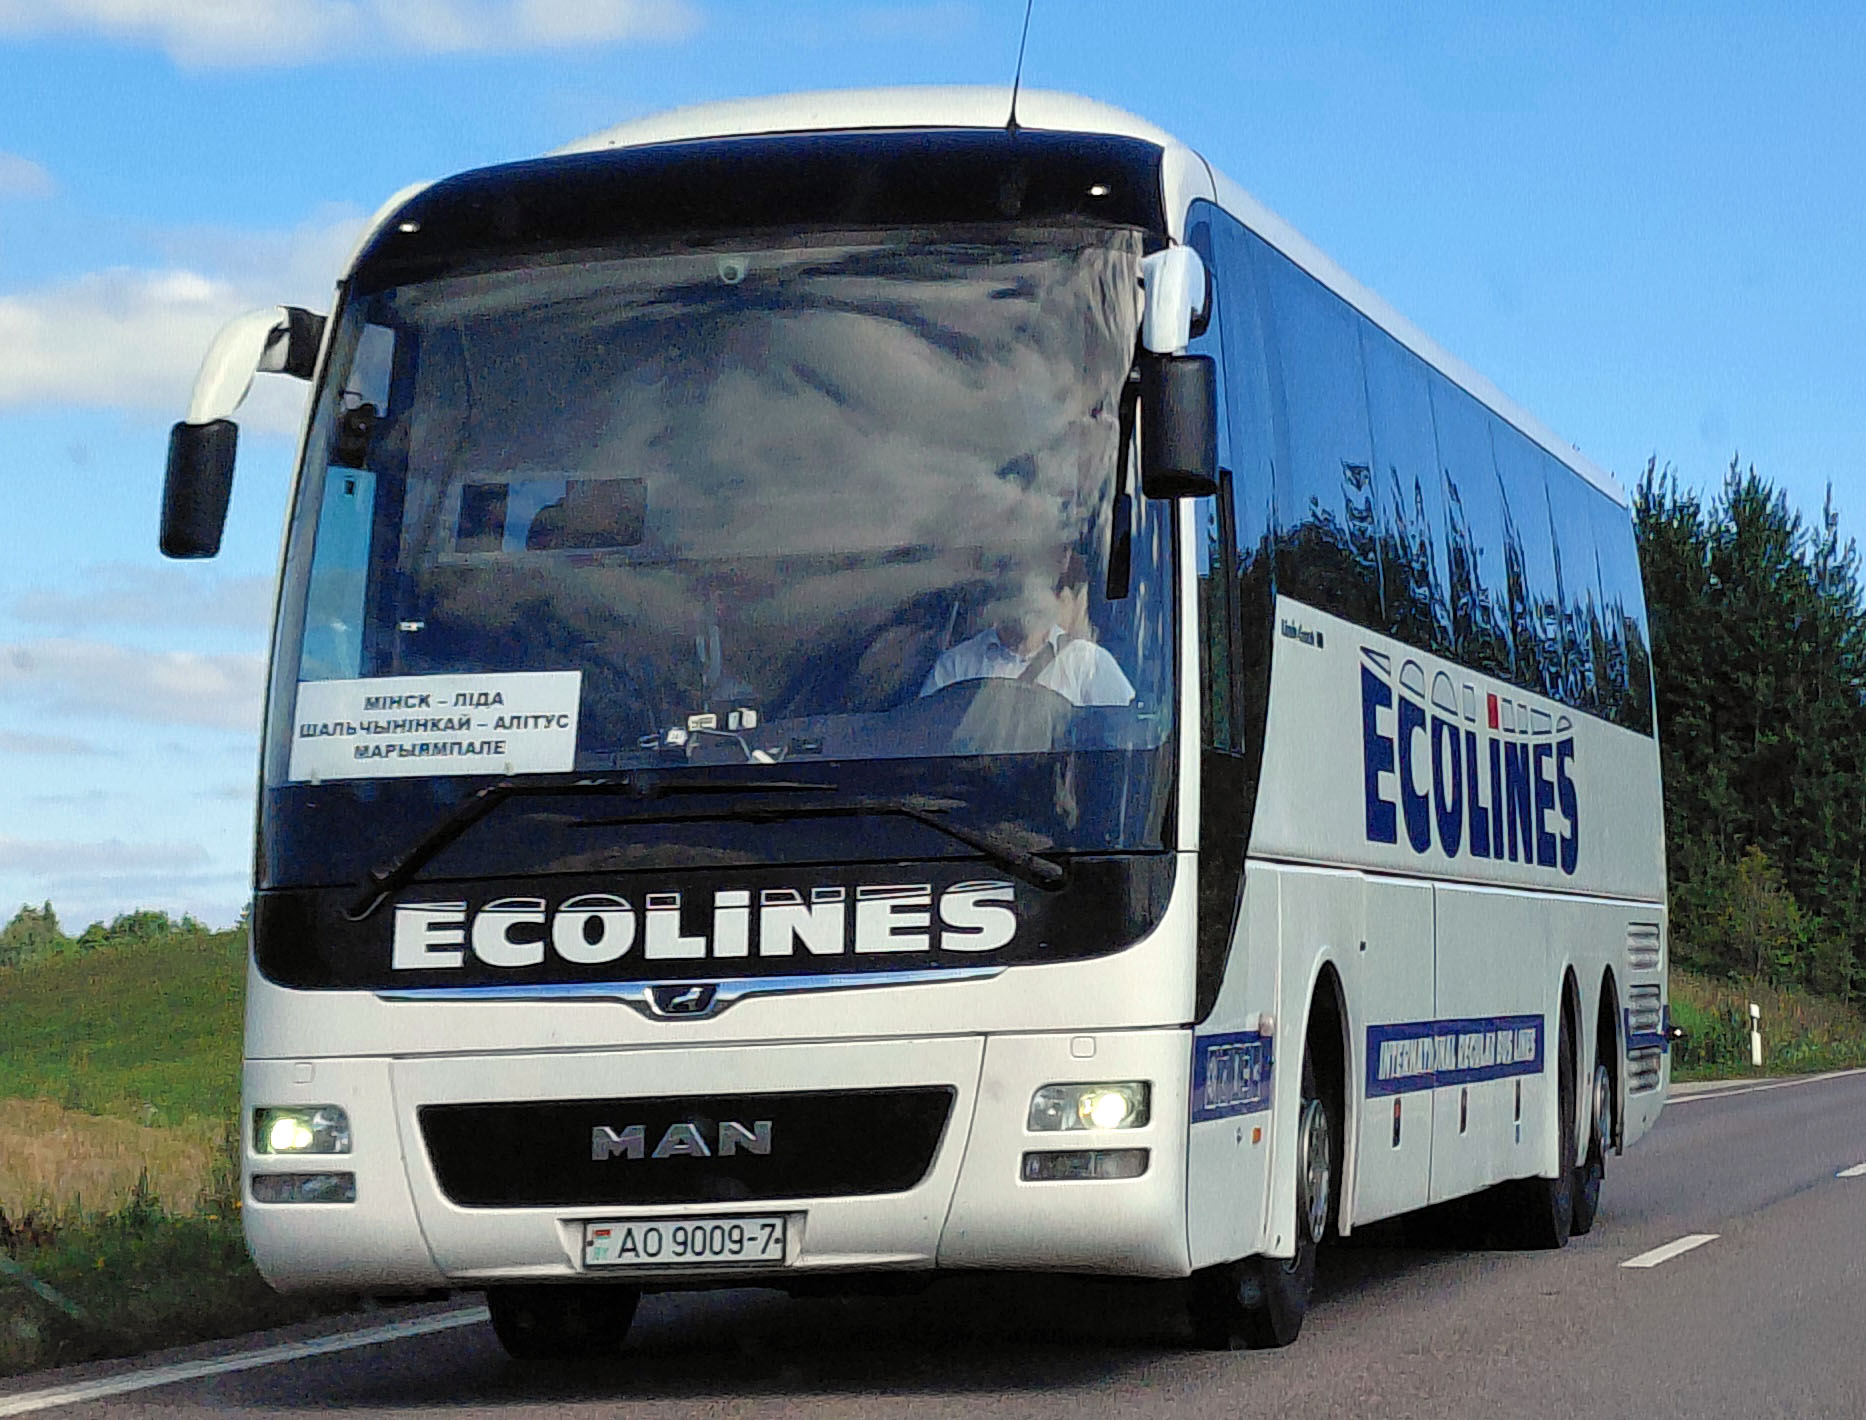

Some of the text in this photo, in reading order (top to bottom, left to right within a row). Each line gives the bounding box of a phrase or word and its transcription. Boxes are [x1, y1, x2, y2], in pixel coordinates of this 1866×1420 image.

[363, 694, 431, 711] МІНСК
[453, 692, 504, 707] ЛІДА
[1360, 645, 1579, 875] ECOLINES
[392, 881, 1017, 969] ECOLINES
[592, 1121, 773, 1161] MAN
[617, 1227, 663, 1259] AO
[672, 1223, 776, 1257] 9009-7
